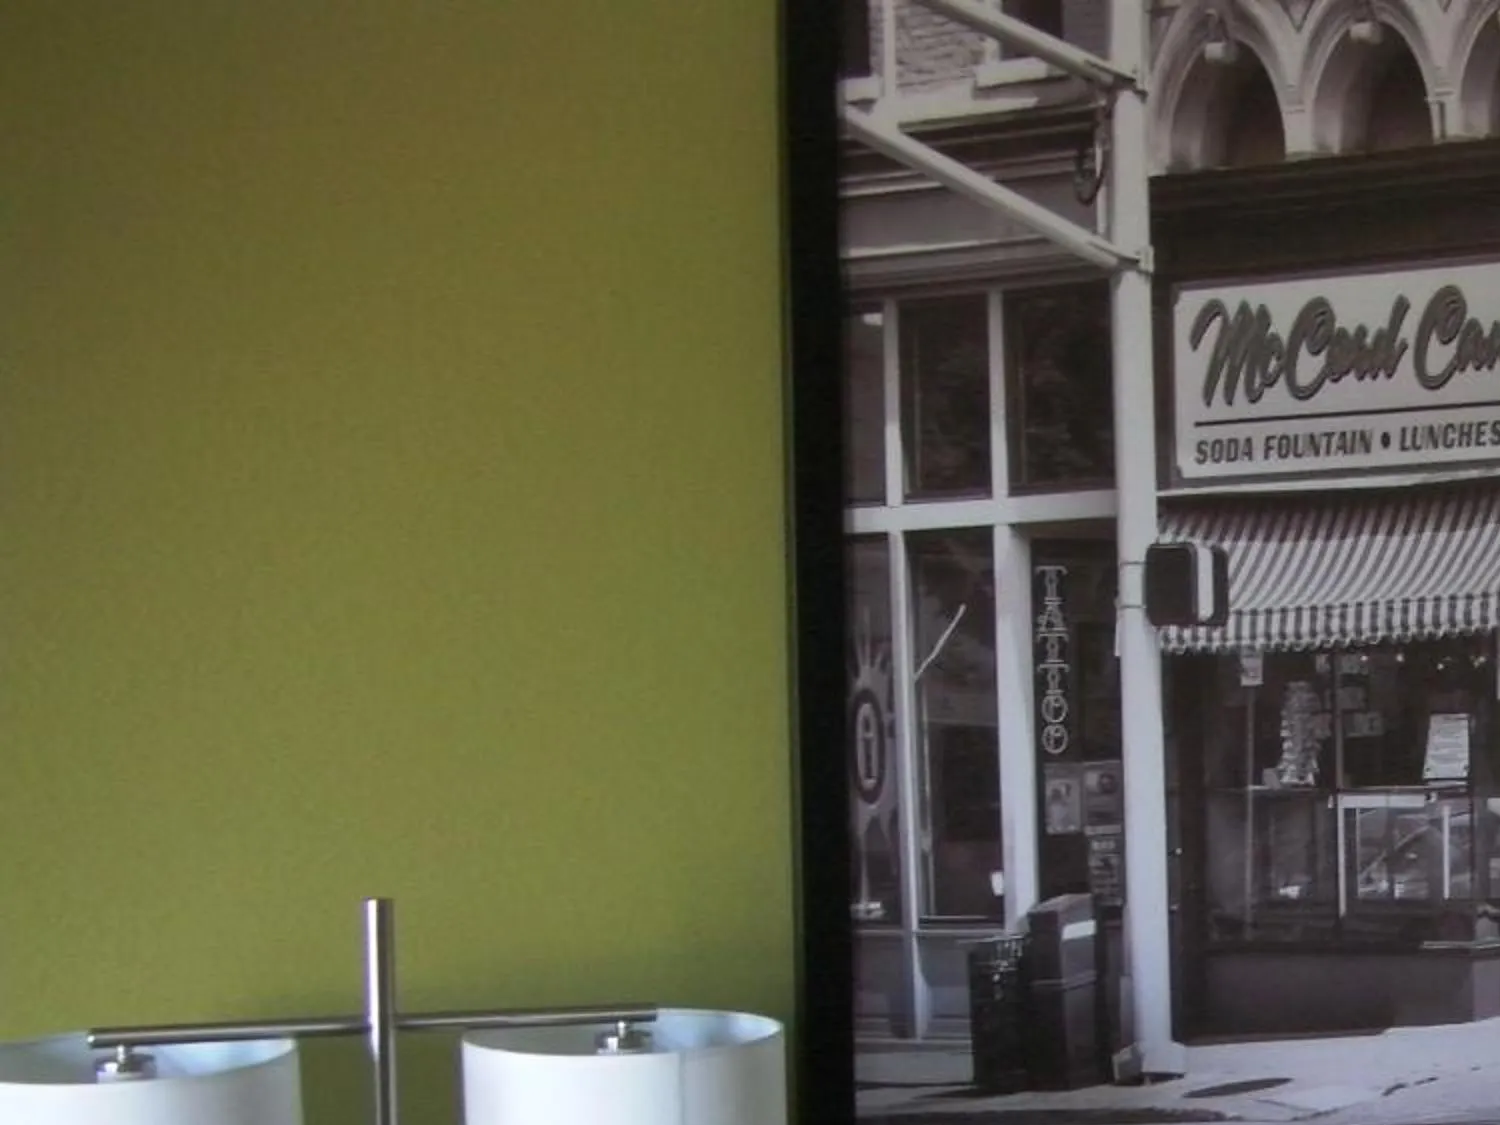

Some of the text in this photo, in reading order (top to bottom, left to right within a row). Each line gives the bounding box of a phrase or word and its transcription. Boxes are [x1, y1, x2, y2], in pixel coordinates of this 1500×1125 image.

[1195, 435, 1253, 465] SODA
[1263, 429, 1372, 459] FOUNTAIN
[1035, 564, 1070, 755] TATTOO
